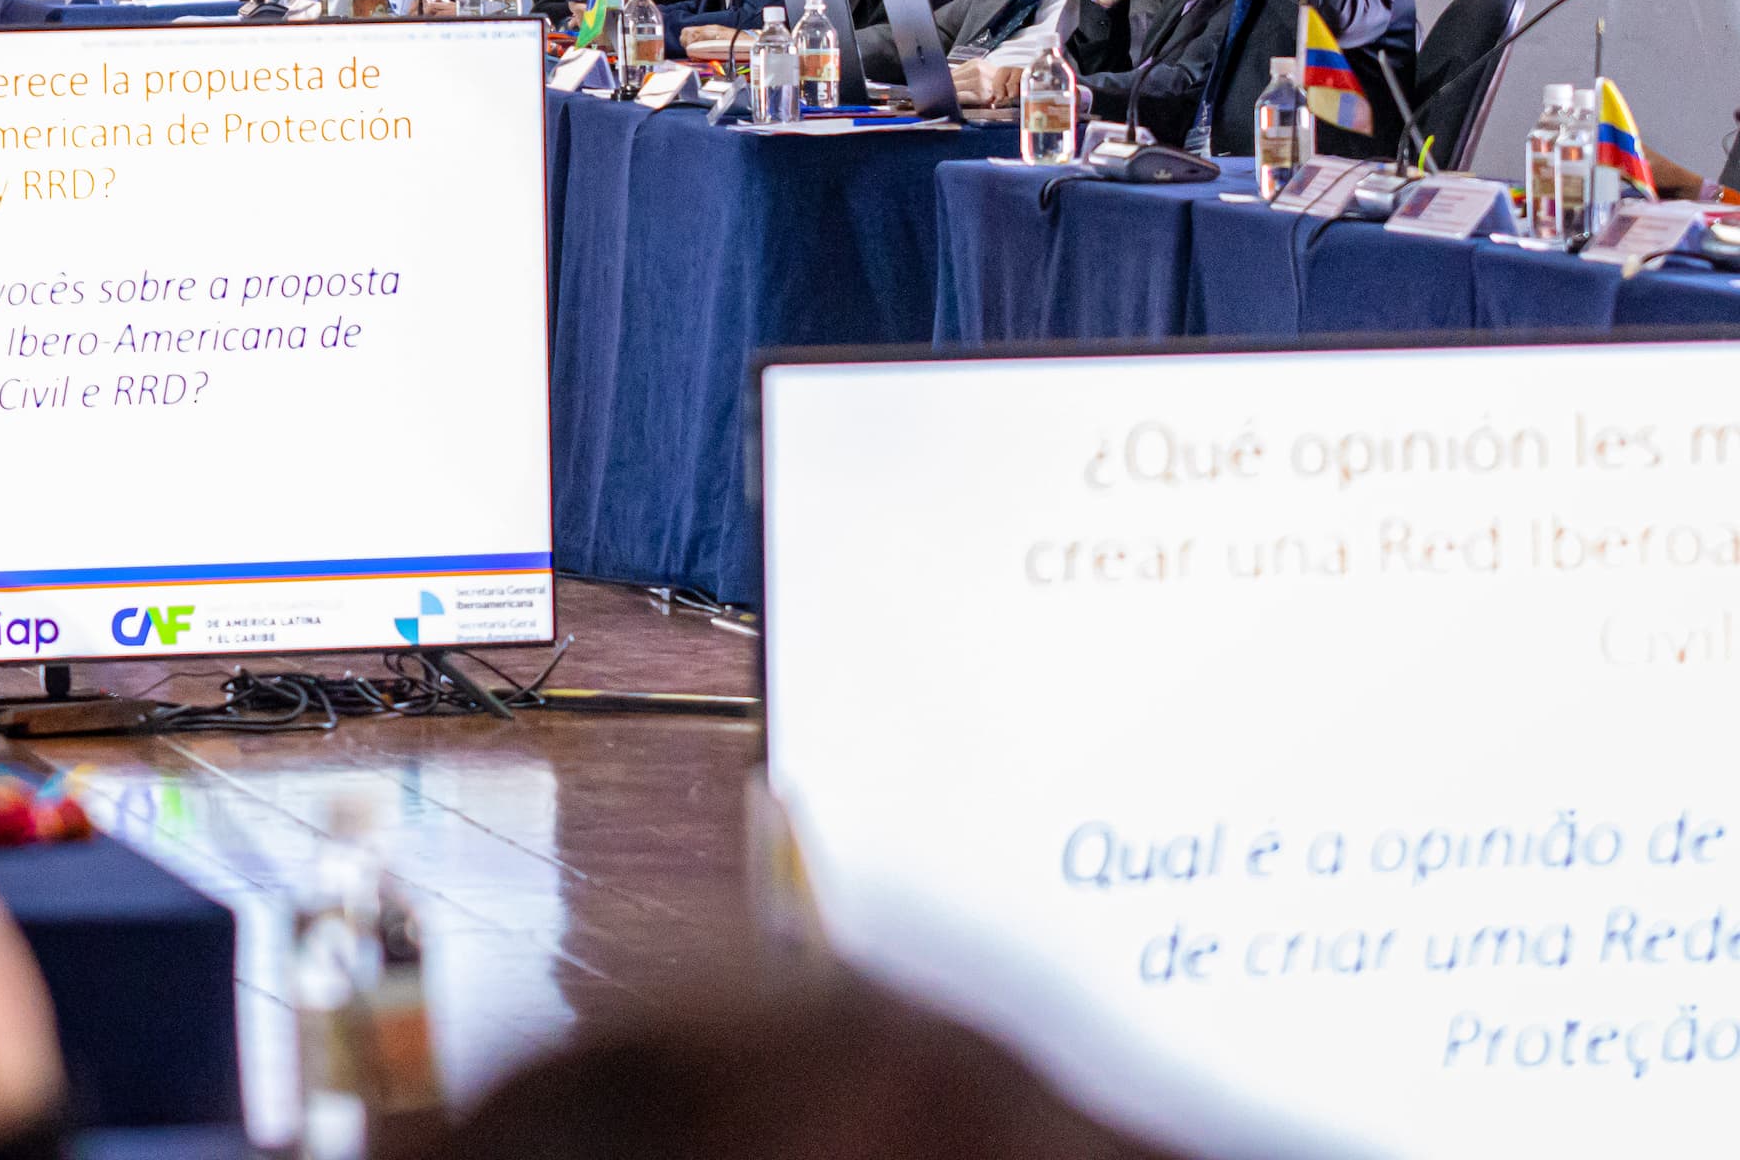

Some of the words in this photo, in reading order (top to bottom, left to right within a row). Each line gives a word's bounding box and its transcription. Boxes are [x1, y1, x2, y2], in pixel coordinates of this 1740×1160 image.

[103, 62, 130, 95] la
[145, 62, 323, 103] propuesta
[338, 56, 380, 89] de
[167, 114, 209, 146] de
[224, 109, 412, 144] Protección
[23, 168, 116, 200] RRD?
[99, 270, 196, 303] sobre
[209, 277, 228, 300] a
[241, 267, 400, 307] proposta
[8, 321, 307, 357] Ibero-Americana
[320, 315, 361, 349] de
[0, 376, 69, 410] Civil
[82, 385, 100, 408] e
[114, 371, 209, 406] RRD?
